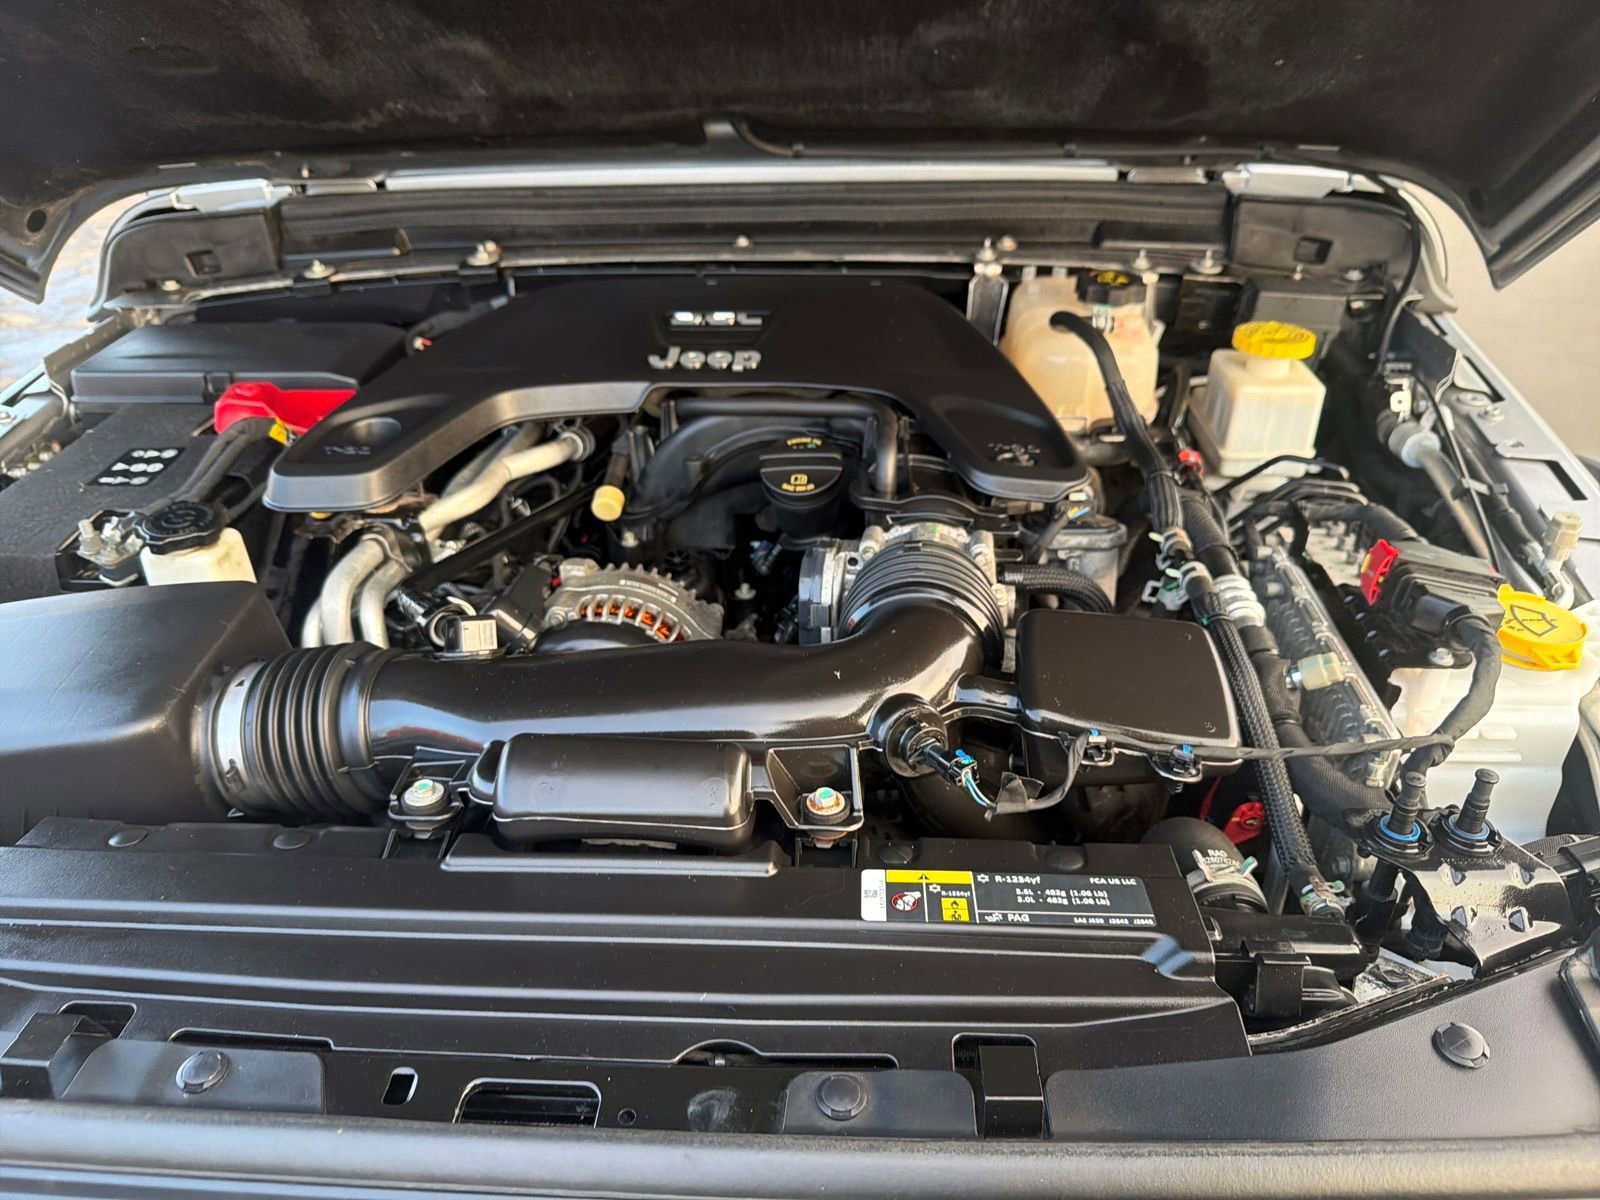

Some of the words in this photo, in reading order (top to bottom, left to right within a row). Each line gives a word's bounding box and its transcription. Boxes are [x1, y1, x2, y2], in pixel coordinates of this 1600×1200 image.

[647, 346, 762, 373] Jeep
[1207, 849, 1228, 857] RAD
[994, 875, 1041, 885] R-1234yf
[1089, 877, 1107, 885] FCA
[1121, 878, 1137, 886] LLC
[1007, 913, 1031, 923] PAG
